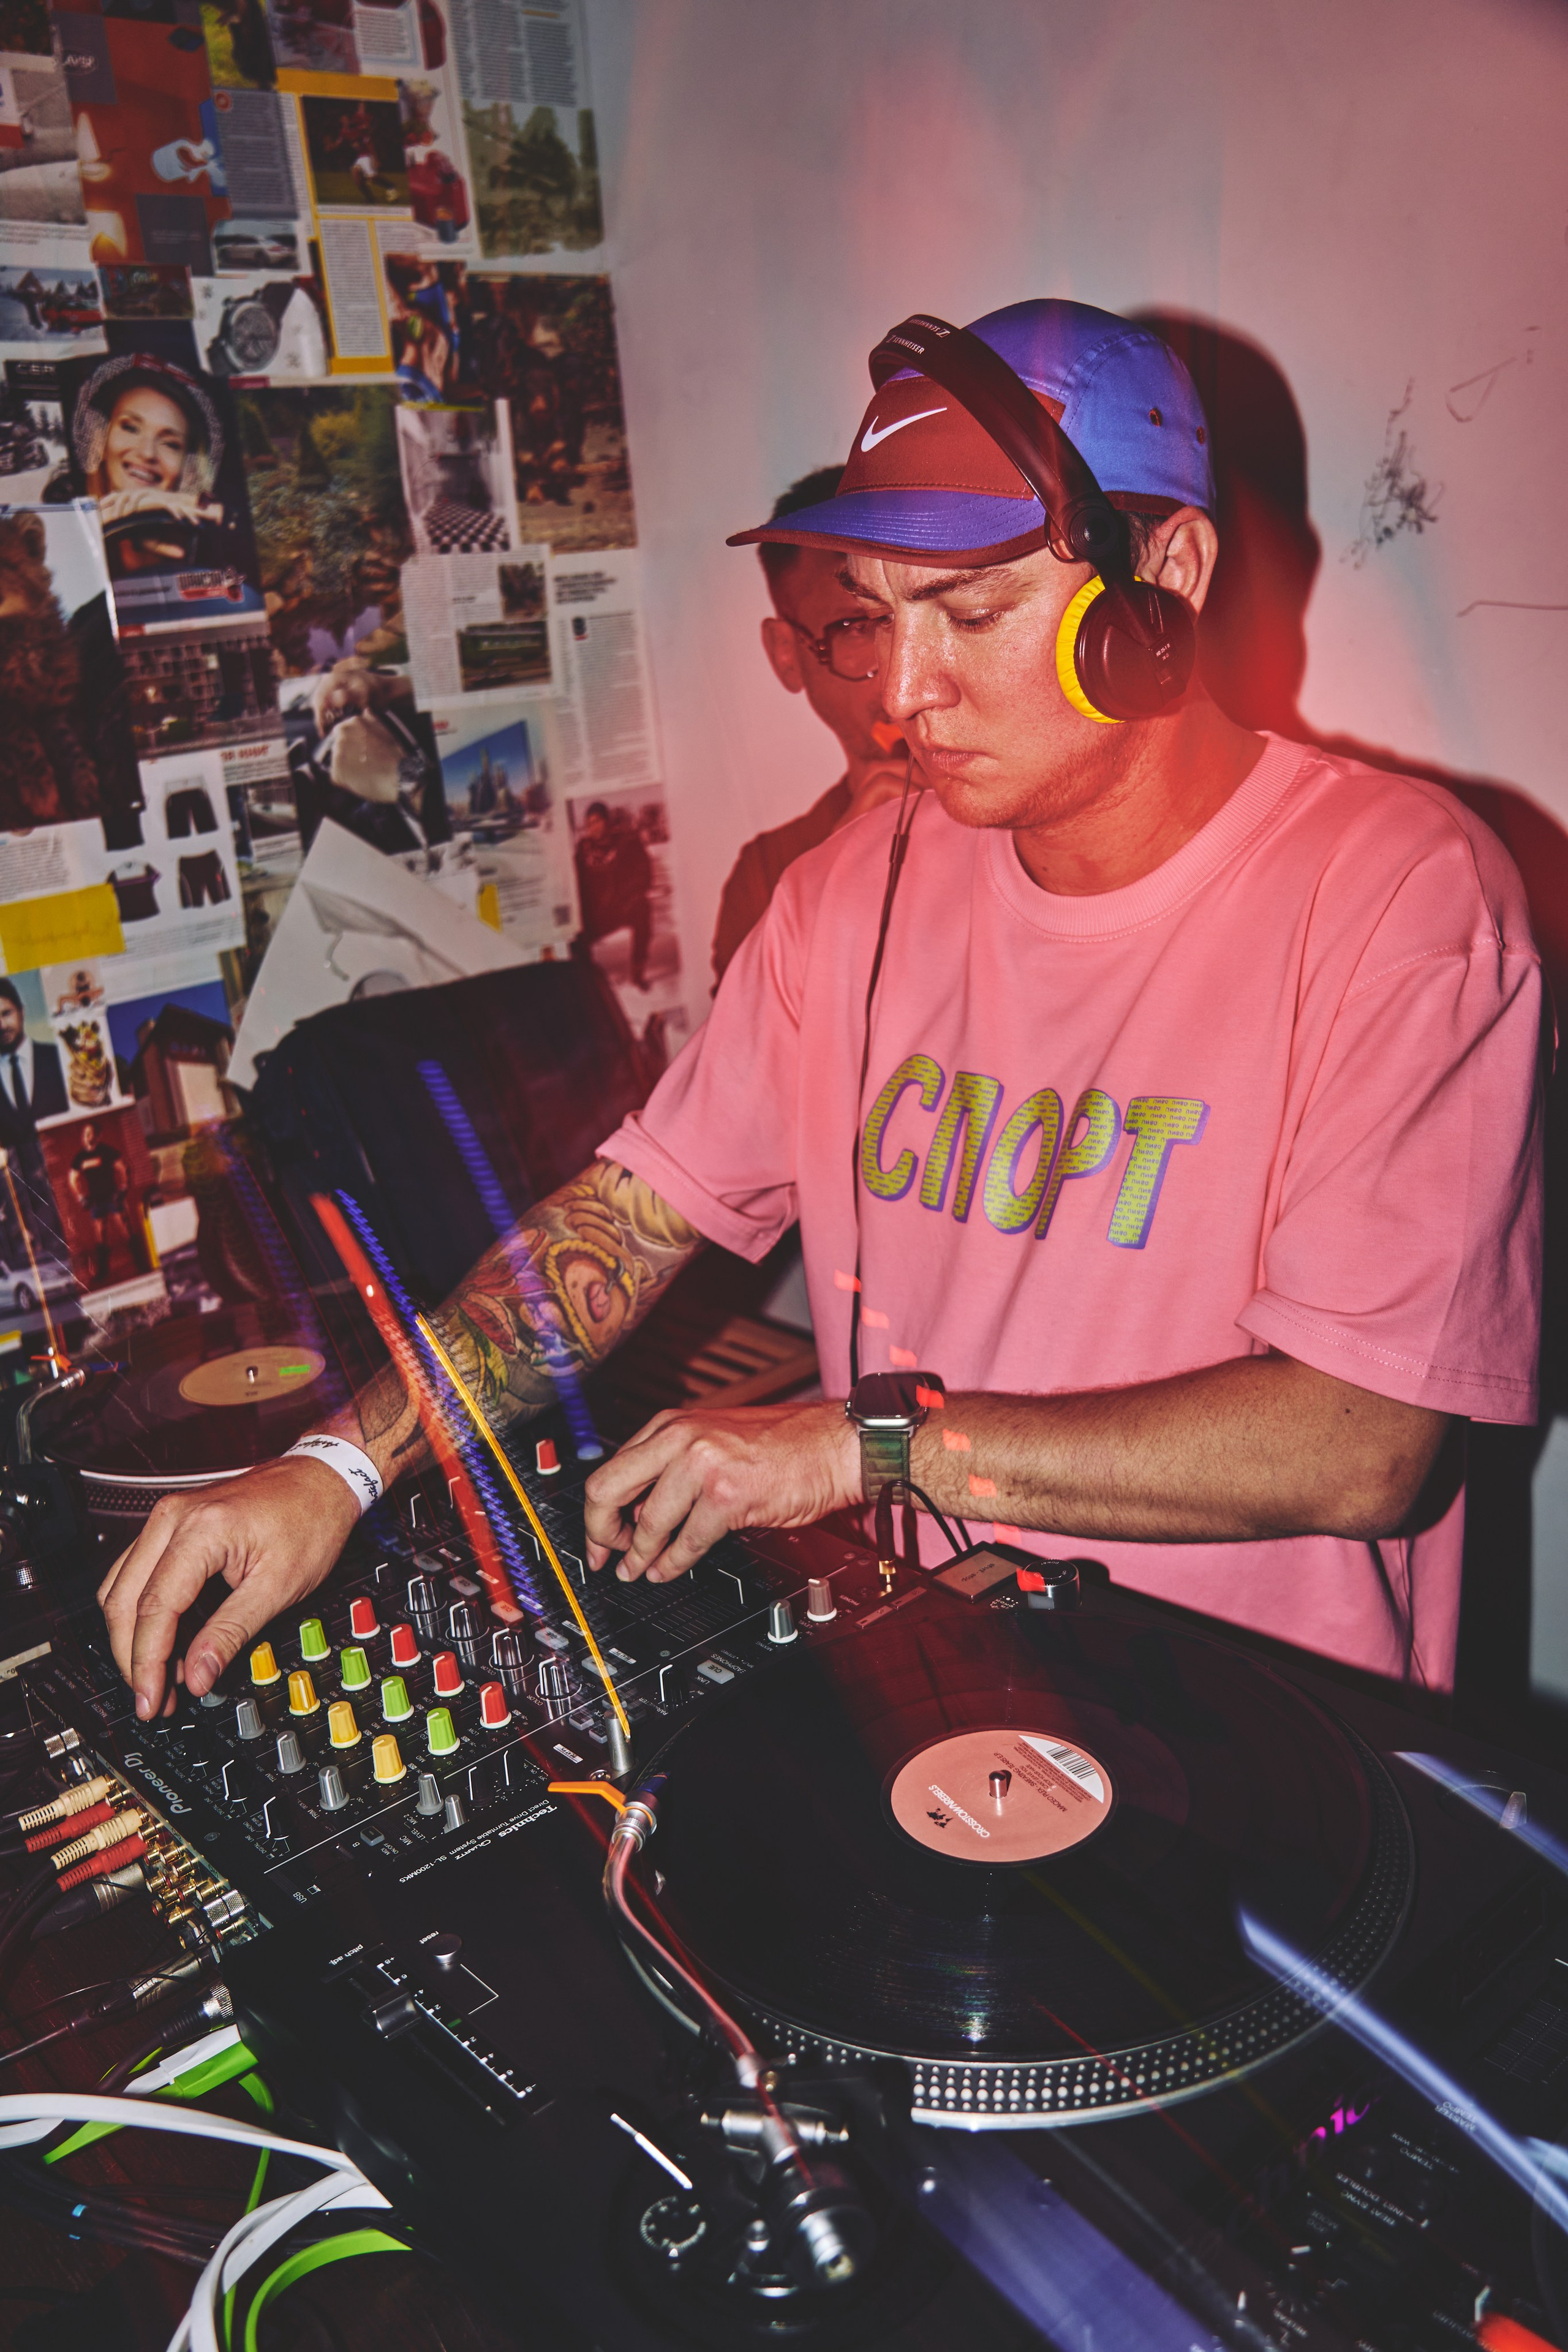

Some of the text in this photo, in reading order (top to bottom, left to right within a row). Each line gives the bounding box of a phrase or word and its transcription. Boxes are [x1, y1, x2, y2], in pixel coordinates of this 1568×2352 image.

[892, 336, 925, 354] SENNHEISER
[798, 1619, 813, 1628] LEVEL
[755, 1641, 774, 1651] MIXING
[480, 1664, 497, 1676] COLOR
[707, 1664, 723, 1673] CUE
[710, 1653, 747, 1674] EADPHONES
[694, 1675, 710, 1685] LINK
[423, 1695, 434, 1705] LOW
[526, 1694, 543, 1706] COLOR
[90, 1702, 109, 1718] MASTER
[371, 1721, 381, 1730] MID
[467, 1727, 480, 1736] LOW
[225, 1737, 237, 1748] TRIM
[415, 1754, 427, 1763] MID
[124, 1752, 192, 1815] Pioneer DJ
[265, 1772, 277, 1783] TRIM
[1012, 1767, 1037, 1787] SWEATING
[202, 1784, 215, 1795] PHONO
[212, 1803, 225, 1815] DIGITAL
[1046, 1795, 1067, 1812] MACEO
[307, 1807, 320, 1820] TRIM
[243, 1820, 257, 1832] PHONO
[448, 1798, 550, 1855] Direct Drive Turntable System
[497, 1804, 558, 1837] Technics
[399, 1834, 413, 1845] MIC
[410, 1827, 426, 1841] LEVEL
[244, 1834, 268, 1854] DIGITAL LINE
[383, 1841, 399, 1855] ON/OFF
[454, 1839, 492, 1860] QUARTZ
[380, 1847, 390, 1856] MIDI
[399, 1854, 448, 1883] SL-1200MK5
[292, 1891, 307, 1904] USB
[418, 1930, 439, 1944] reset
[328, 1943, 364, 1966] pitch adj.
[1399, 2146, 1433, 2170] TEMPO
[1335, 2171, 1379, 2202] DOUBLES
[1340, 2188, 1396, 2226] BEAT SYNC
